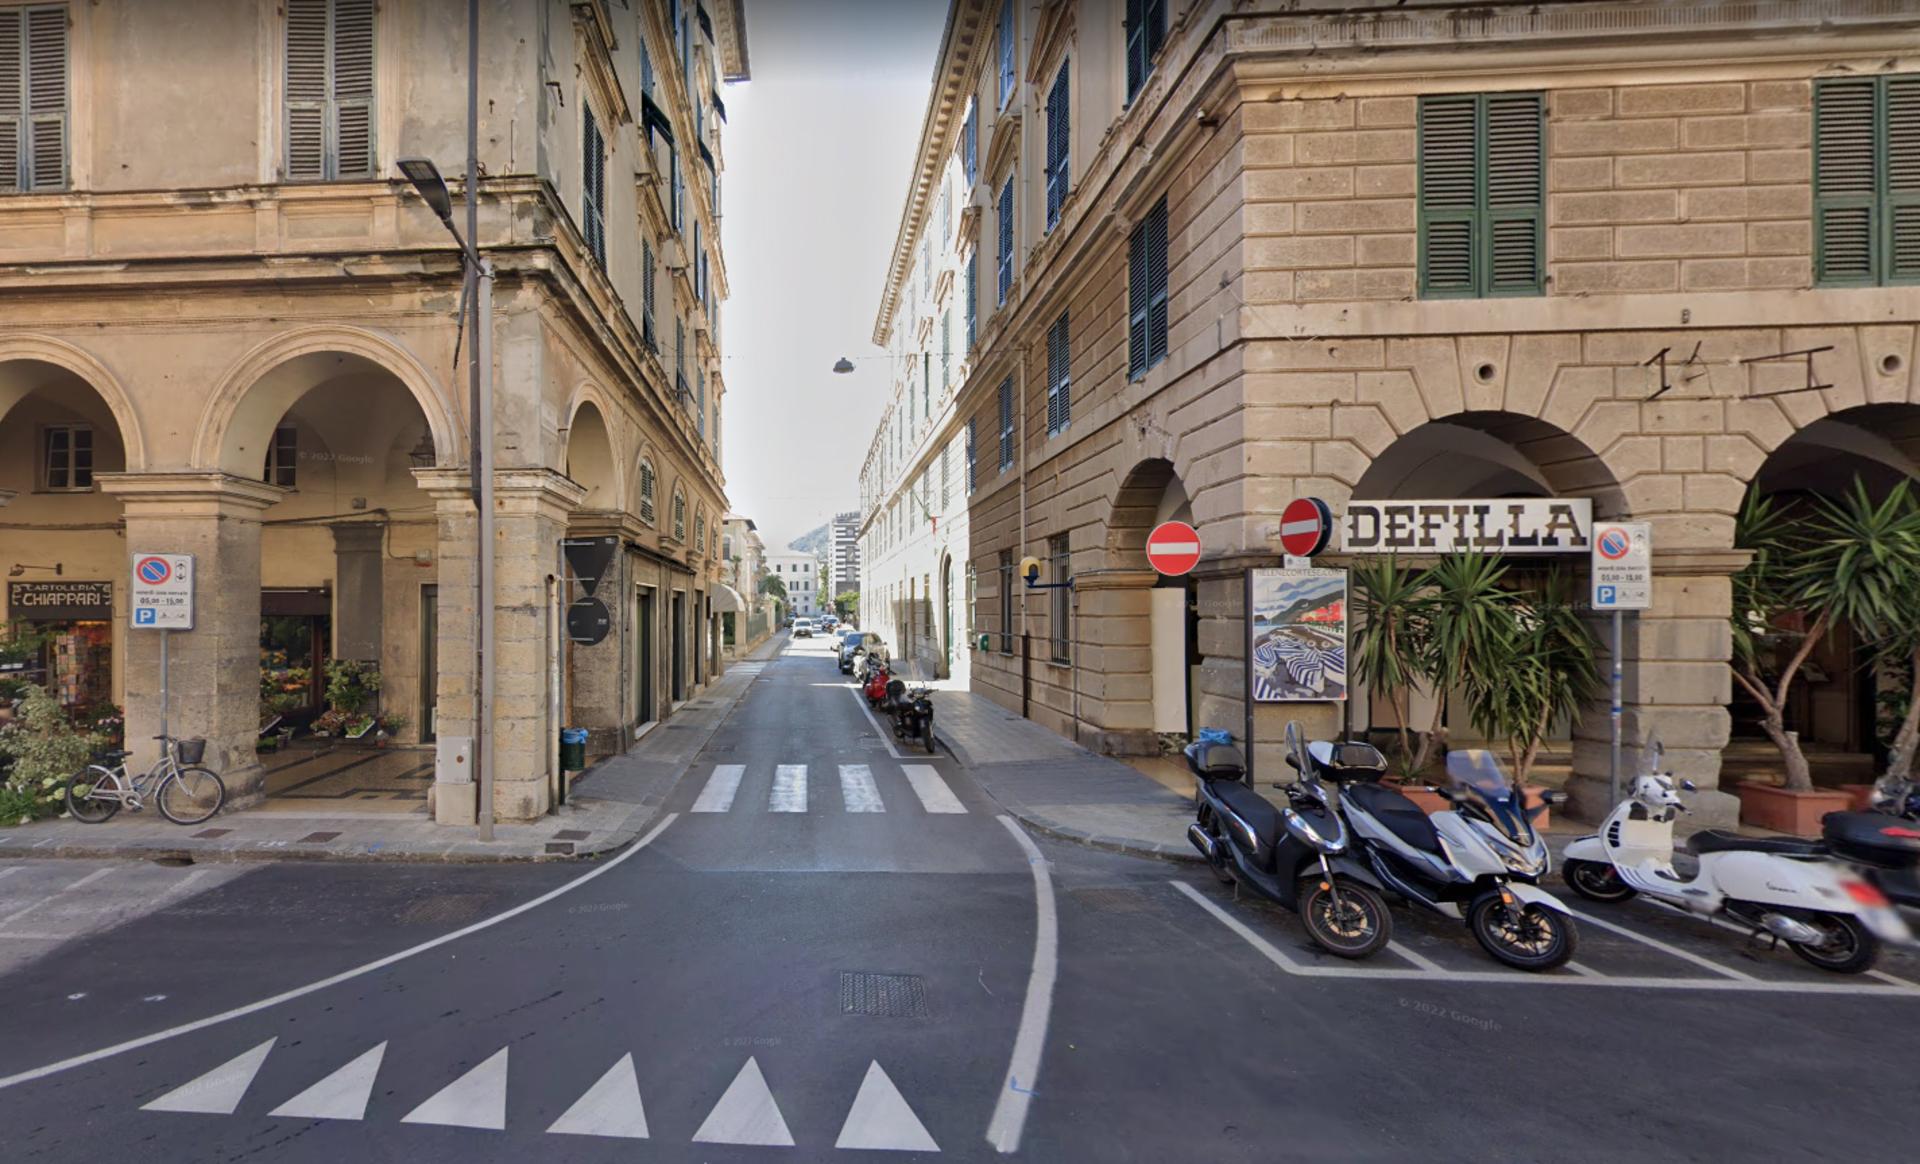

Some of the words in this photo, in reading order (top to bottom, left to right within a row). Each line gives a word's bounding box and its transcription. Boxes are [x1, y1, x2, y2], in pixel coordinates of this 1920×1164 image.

[1347, 504, 1588, 547] DEFILLA
[25, 584, 97, 592] CARTOLERIA
[1600, 588, 1613, 602] P
[22, 592, 101, 606] CHIAPPARI
[140, 610, 152, 623] P
